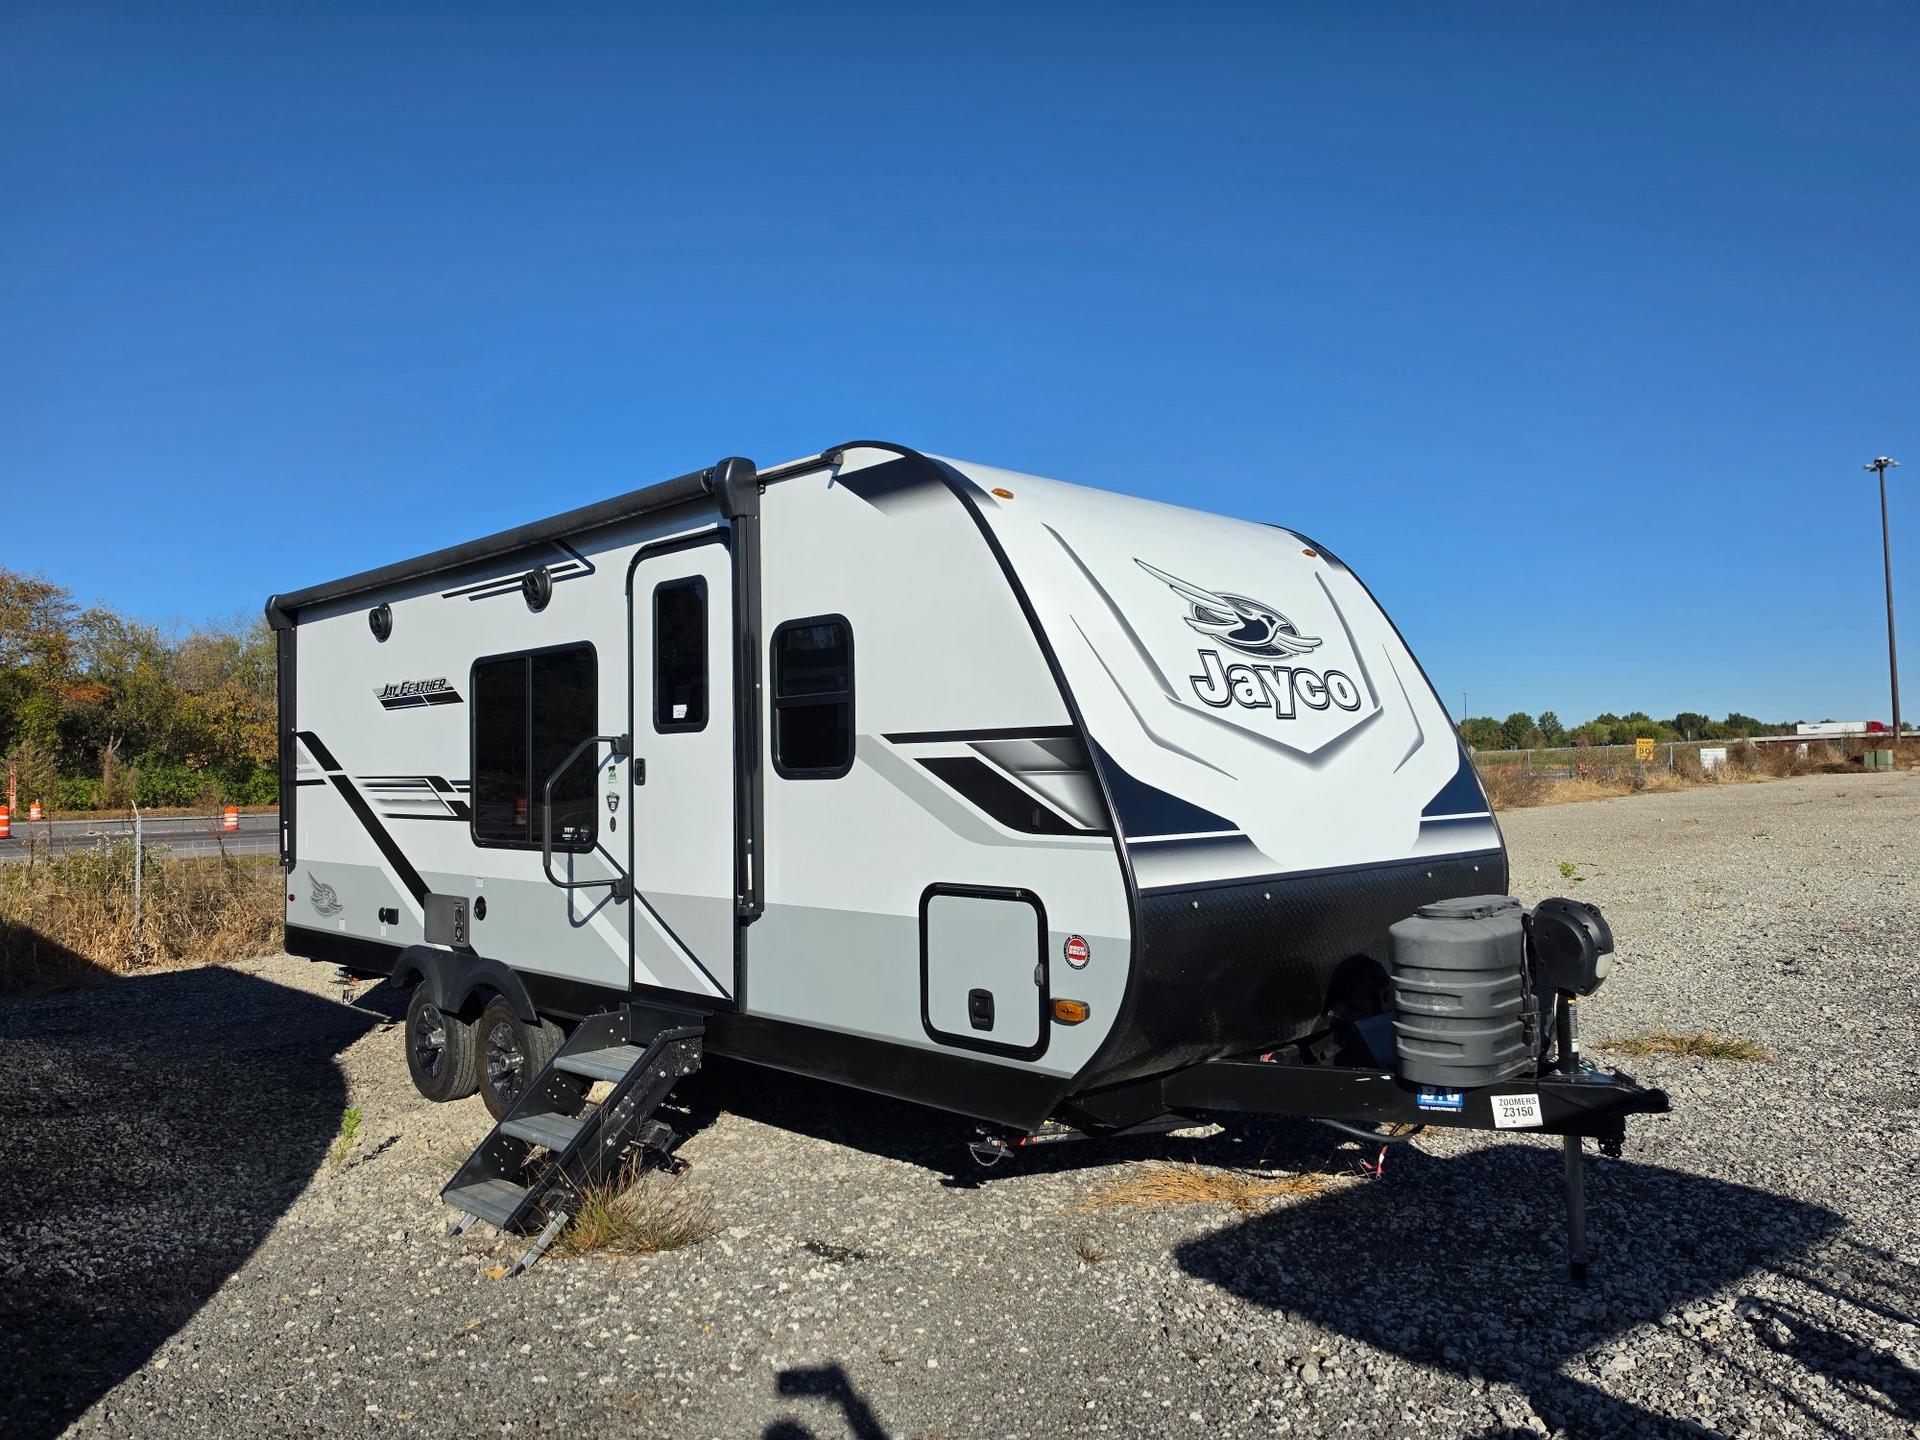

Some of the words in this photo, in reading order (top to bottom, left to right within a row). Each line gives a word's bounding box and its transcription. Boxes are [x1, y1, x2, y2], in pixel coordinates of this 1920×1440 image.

[380, 684, 398, 697] JAY
[400, 679, 446, 695] FEATHER
[1189, 648, 1362, 720] Jayco
[1498, 1097, 1537, 1106] ZOOMERS
[1502, 1106, 1534, 1118] Z3150
